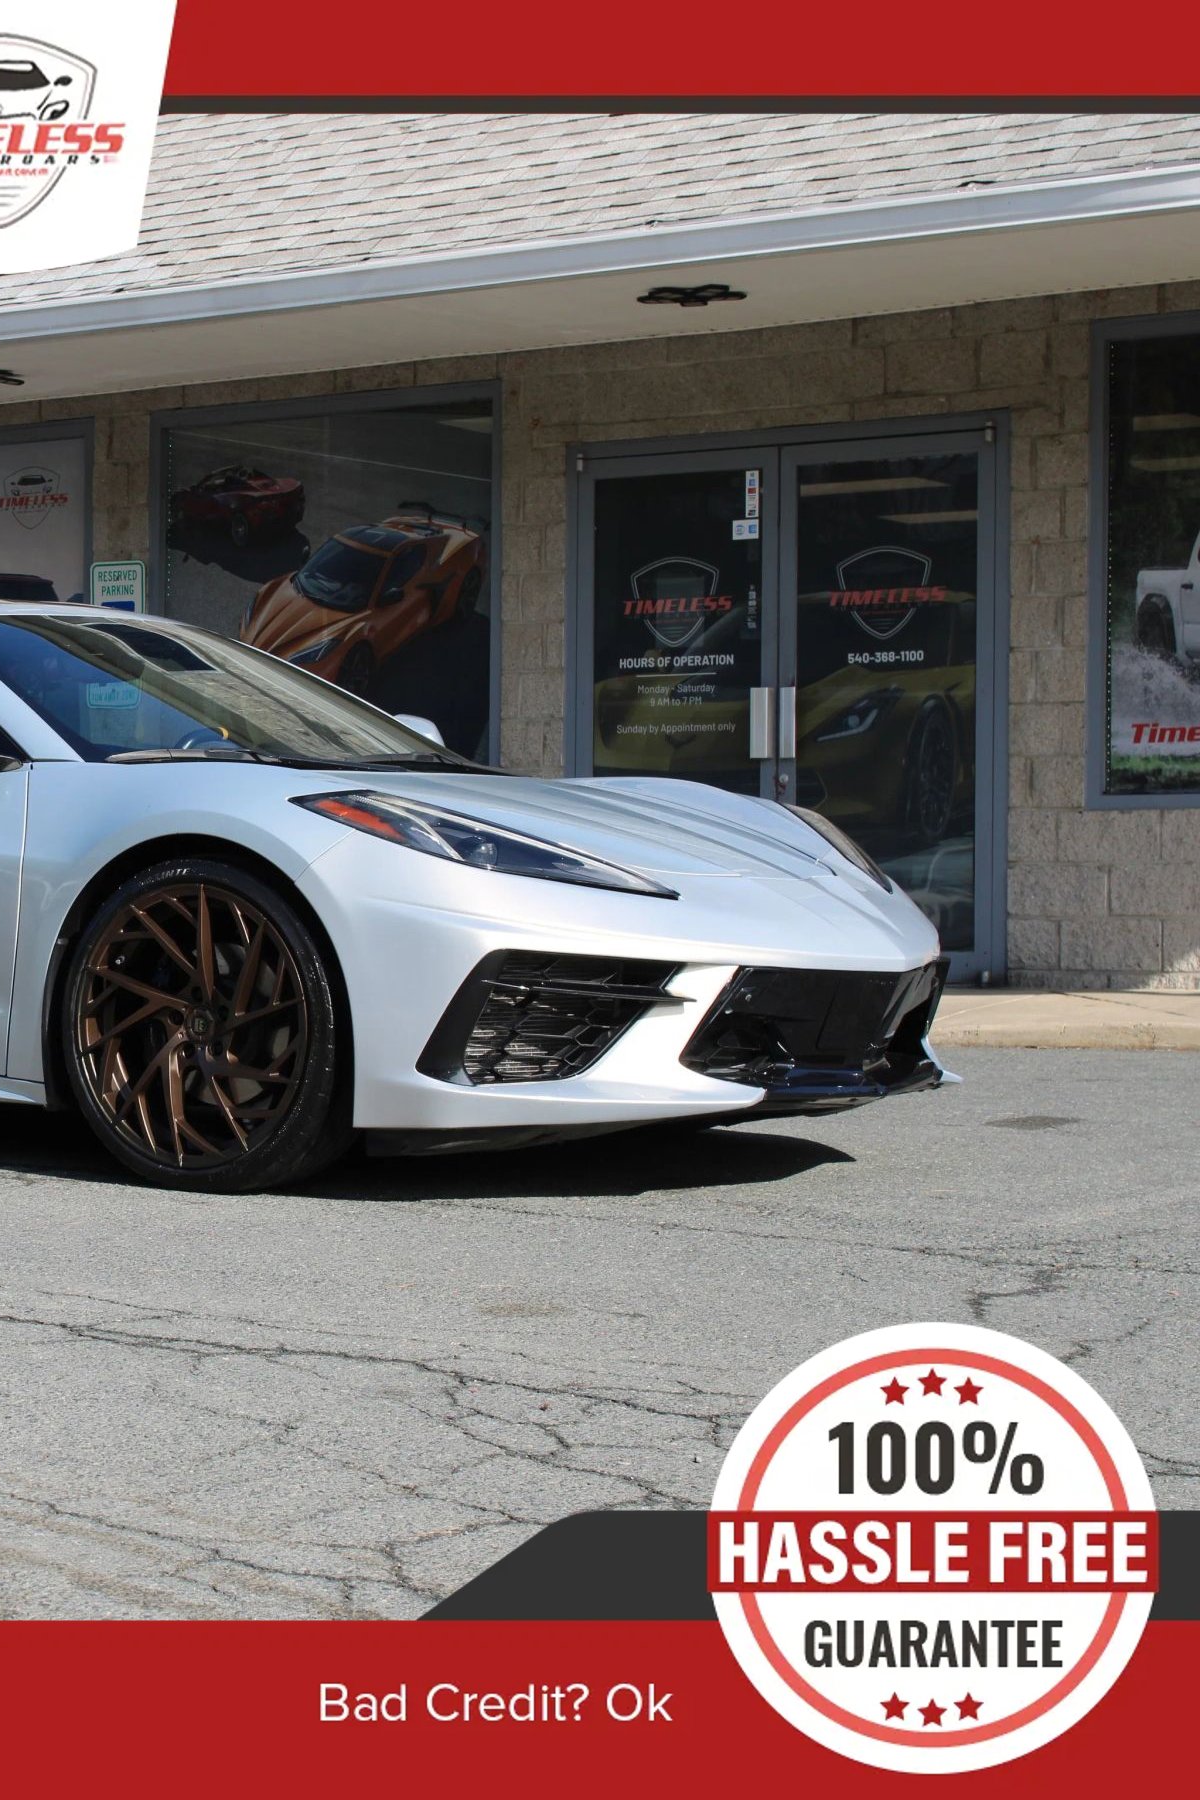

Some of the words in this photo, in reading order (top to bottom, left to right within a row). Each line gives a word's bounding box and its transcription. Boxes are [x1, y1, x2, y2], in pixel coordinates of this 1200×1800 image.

[98, 570, 138, 582] RESERVED
[101, 584, 135, 596] PARKING
[829, 586, 948, 607] TIMELESS
[623, 596, 732, 616] TIMELESS
[619, 658, 655, 669] HOURS
[657, 656, 672, 668] OF
[673, 654, 735, 667] OPERATION
[847, 650, 925, 664] 540-368-1100
[637, 684, 670, 695] Monday
[677, 683, 715, 695] Saturday
[657, 698, 670, 707] AM
[671, 698, 681, 706] to
[682, 697, 688, 706] 7
[690, 696, 702, 705] PM
[616, 724, 648, 734] Sunday
[649, 724, 659, 734] by
[660, 722, 716, 734] Appointment
[717, 721, 736, 732] only
